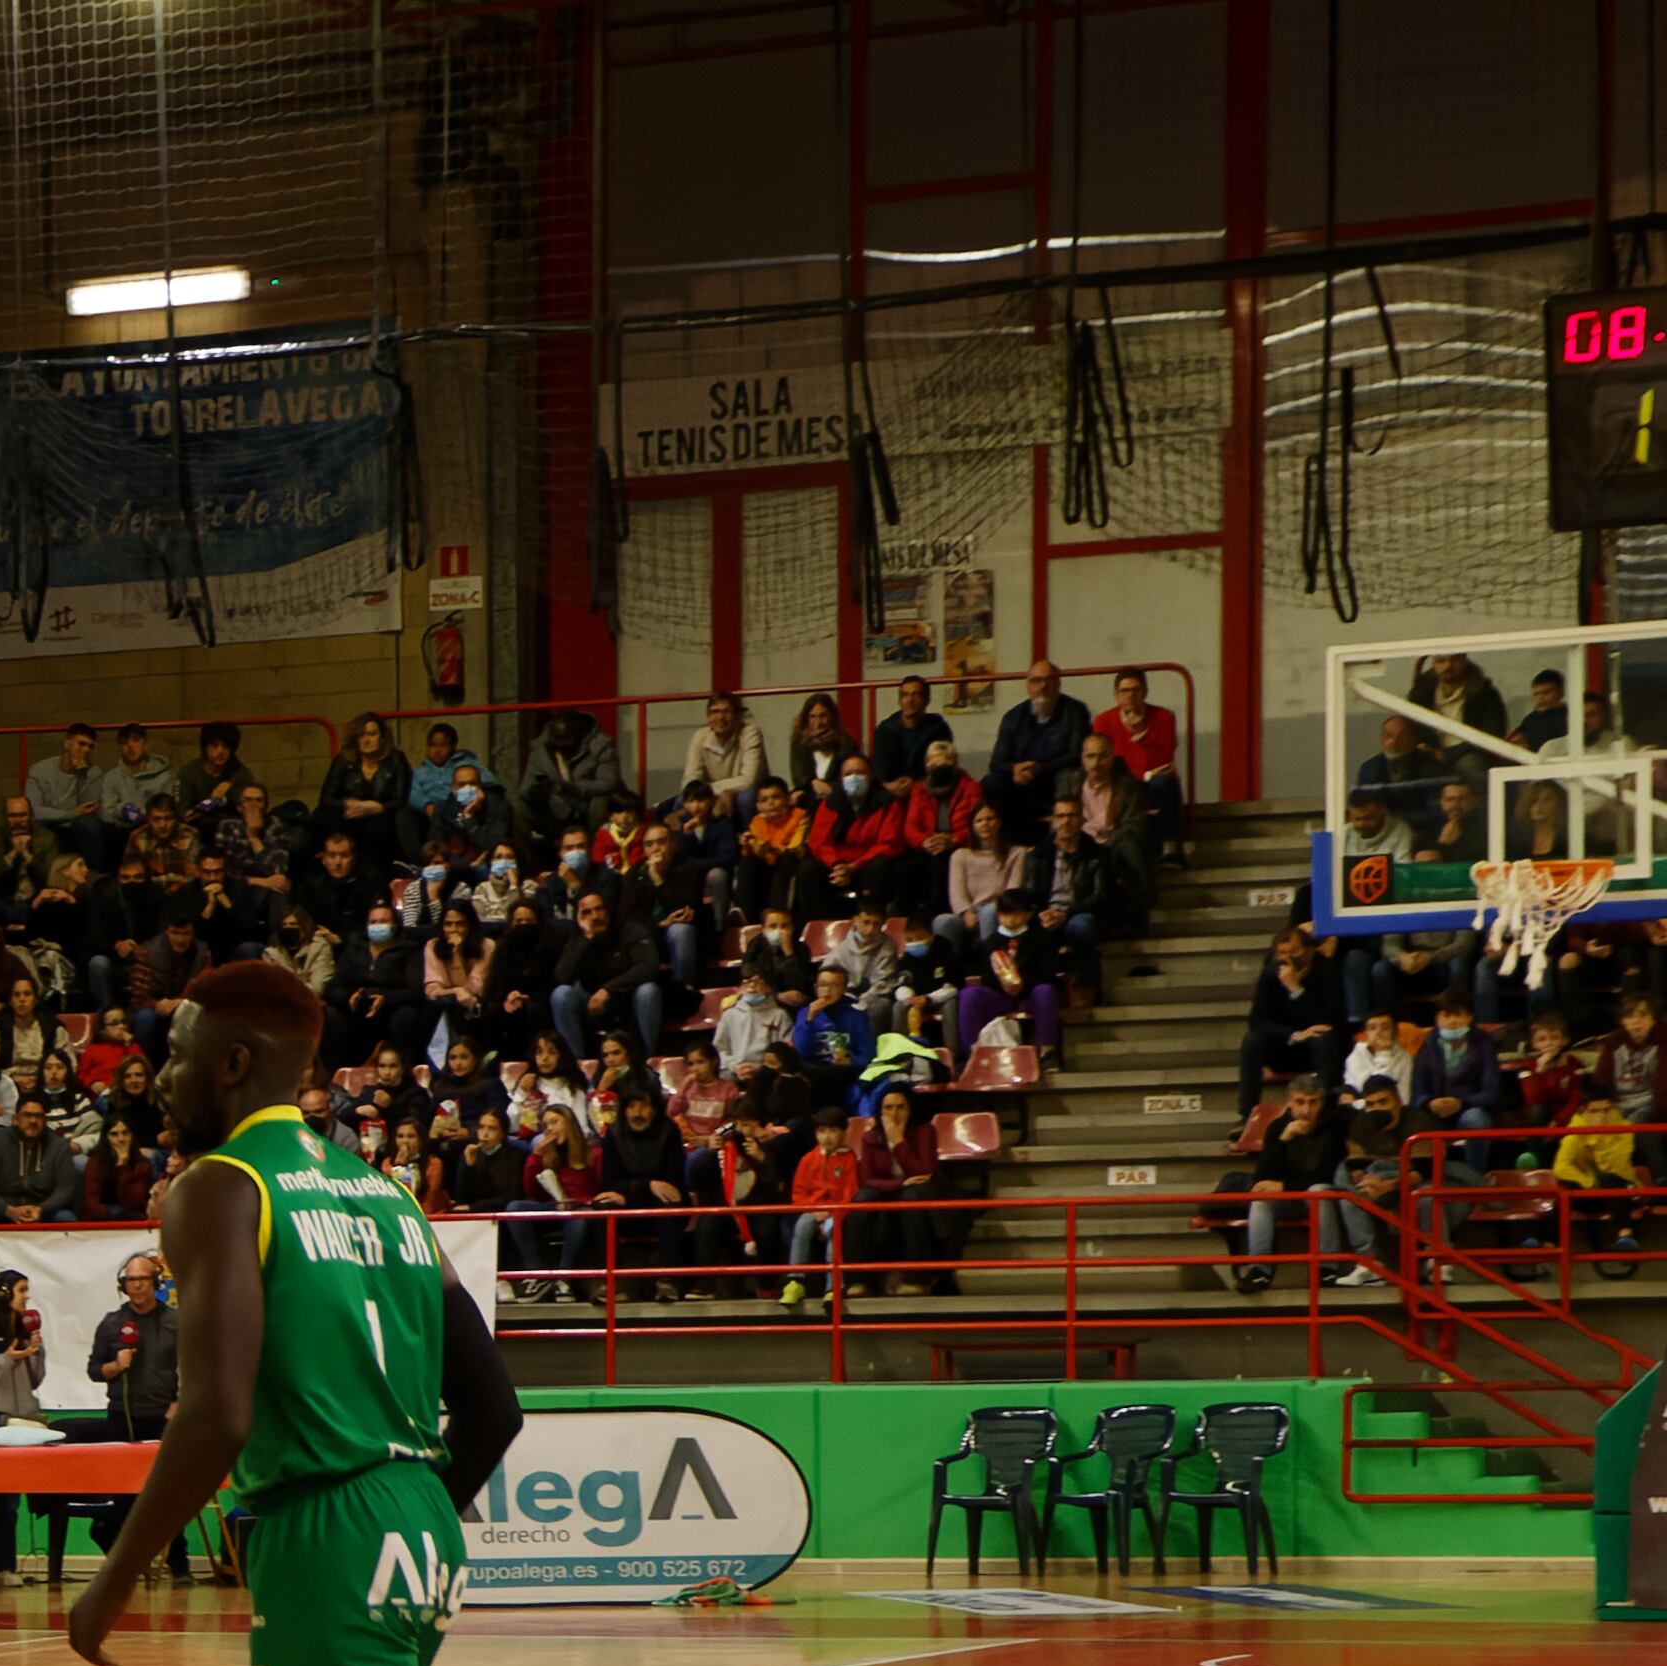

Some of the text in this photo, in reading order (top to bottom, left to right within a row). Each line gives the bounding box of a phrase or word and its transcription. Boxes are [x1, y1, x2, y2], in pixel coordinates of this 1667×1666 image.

[60, 352, 330, 398] AYUNAMIENTO
[709, 376, 792, 420] SALA
[637, 413, 859, 467] TENIS DE MES
[1635, 388, 1655, 464] 1
[397, 1213, 433, 1267] JR
[461, 1437, 738, 1547] legA
[481, 1526, 571, 1545] derecho
[618, 1562, 658, 1578] 900
[663, 1560, 703, 1577] 525
[707, 1559, 747, 1576] 672
